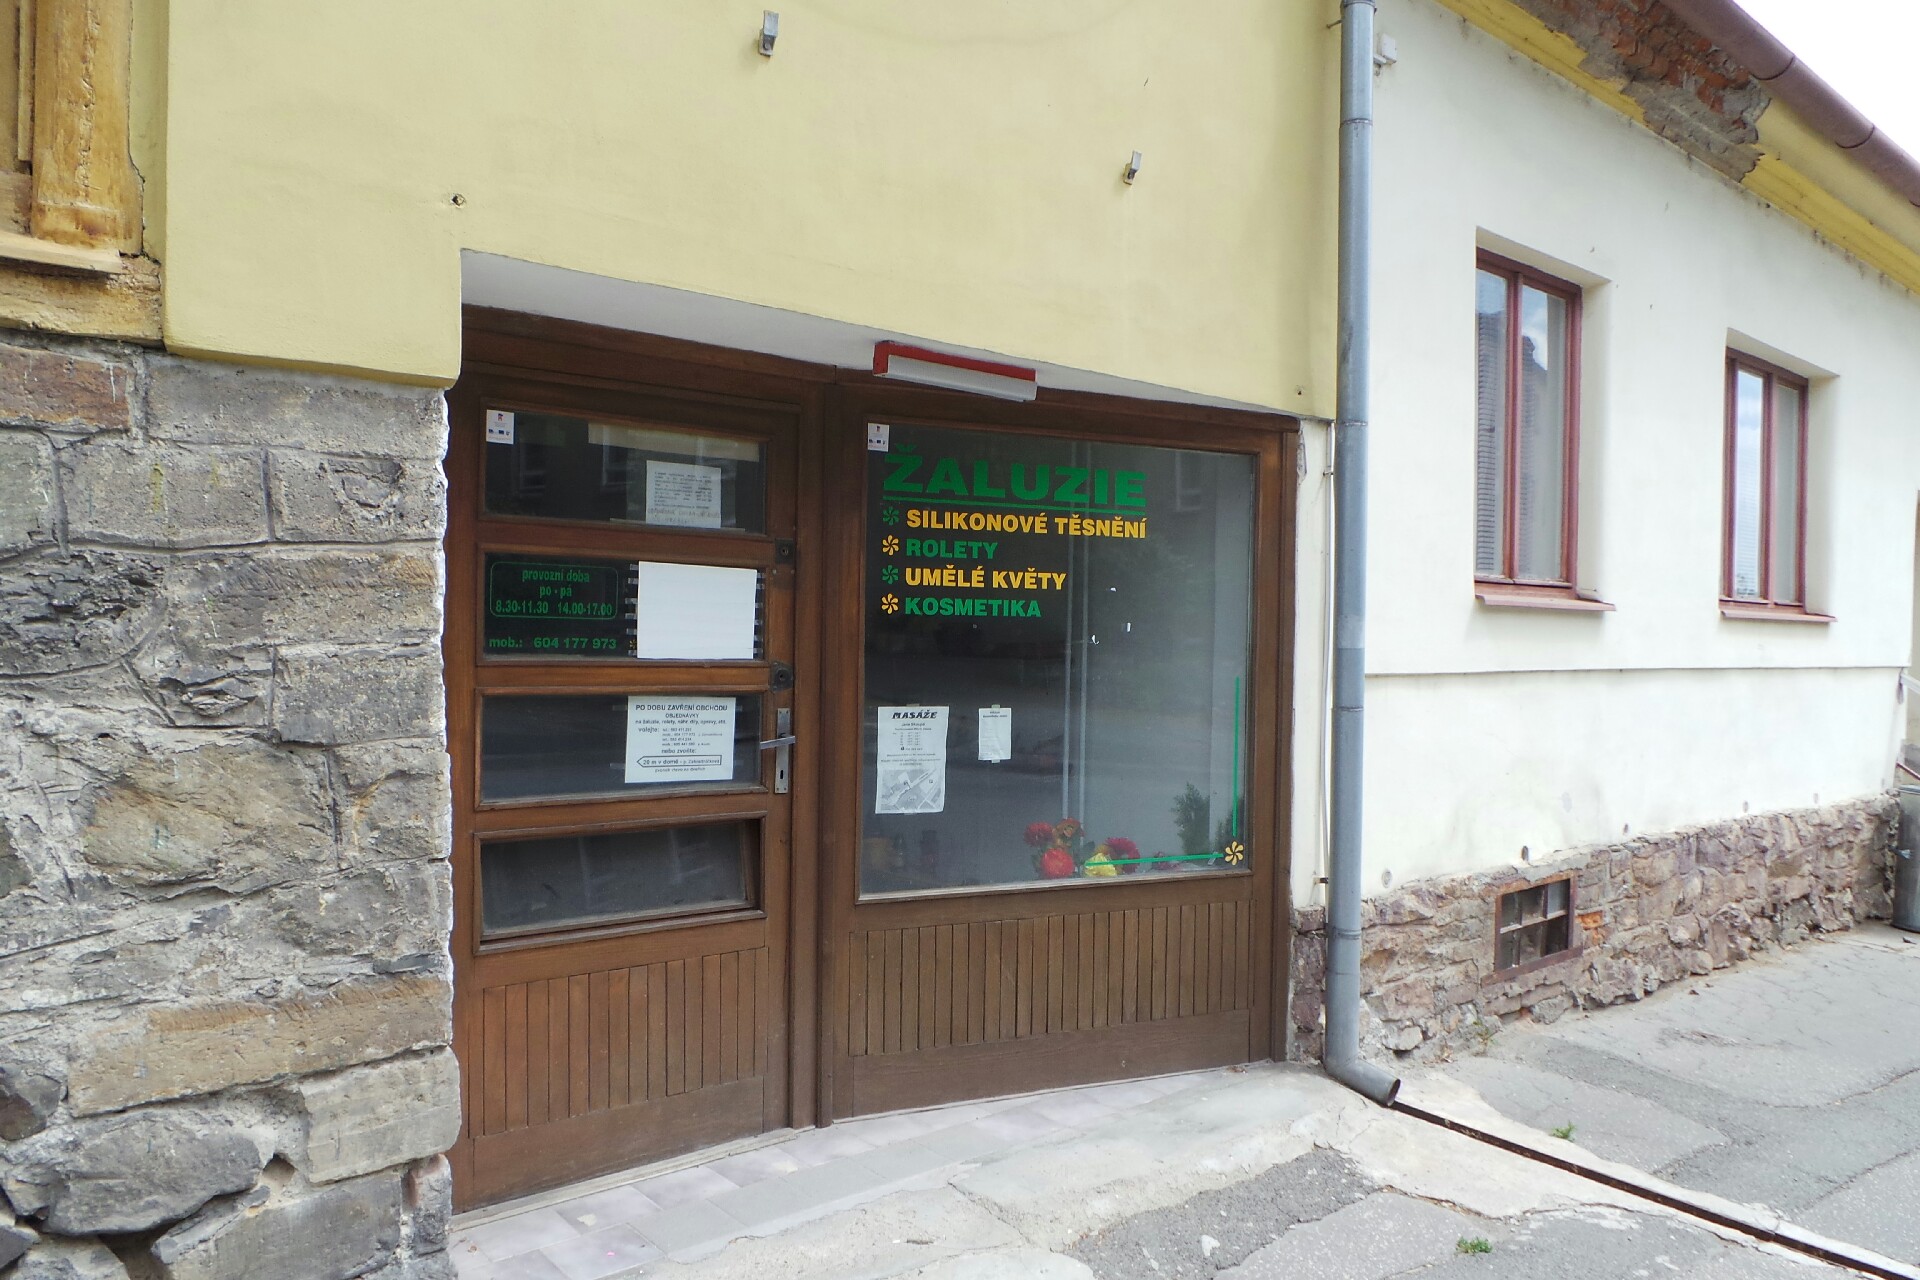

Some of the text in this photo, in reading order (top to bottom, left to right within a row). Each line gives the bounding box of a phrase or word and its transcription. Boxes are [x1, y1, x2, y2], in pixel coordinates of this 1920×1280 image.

[883, 443, 1147, 507] ŽALUZIE
[906, 509, 1147, 539] SILIKONOVÉ TĚSNĚNÍ
[906, 538, 998, 560] ROLETY
[522, 569, 590, 583] provozní doba
[905, 564, 1067, 591] UMĚLÉ KVĚTY
[539, 586, 552, 599] po
[560, 584, 572, 599] pá
[495, 600, 613, 616] 8.30-11.30 14.00-17.00
[905, 597, 1042, 618] KOSMETIKA
[489, 637, 617, 650] mob.: 604 177 973
[667, 703, 695, 711] ZAVŘENÍ
[892, 709, 938, 720] MASÁŽE
